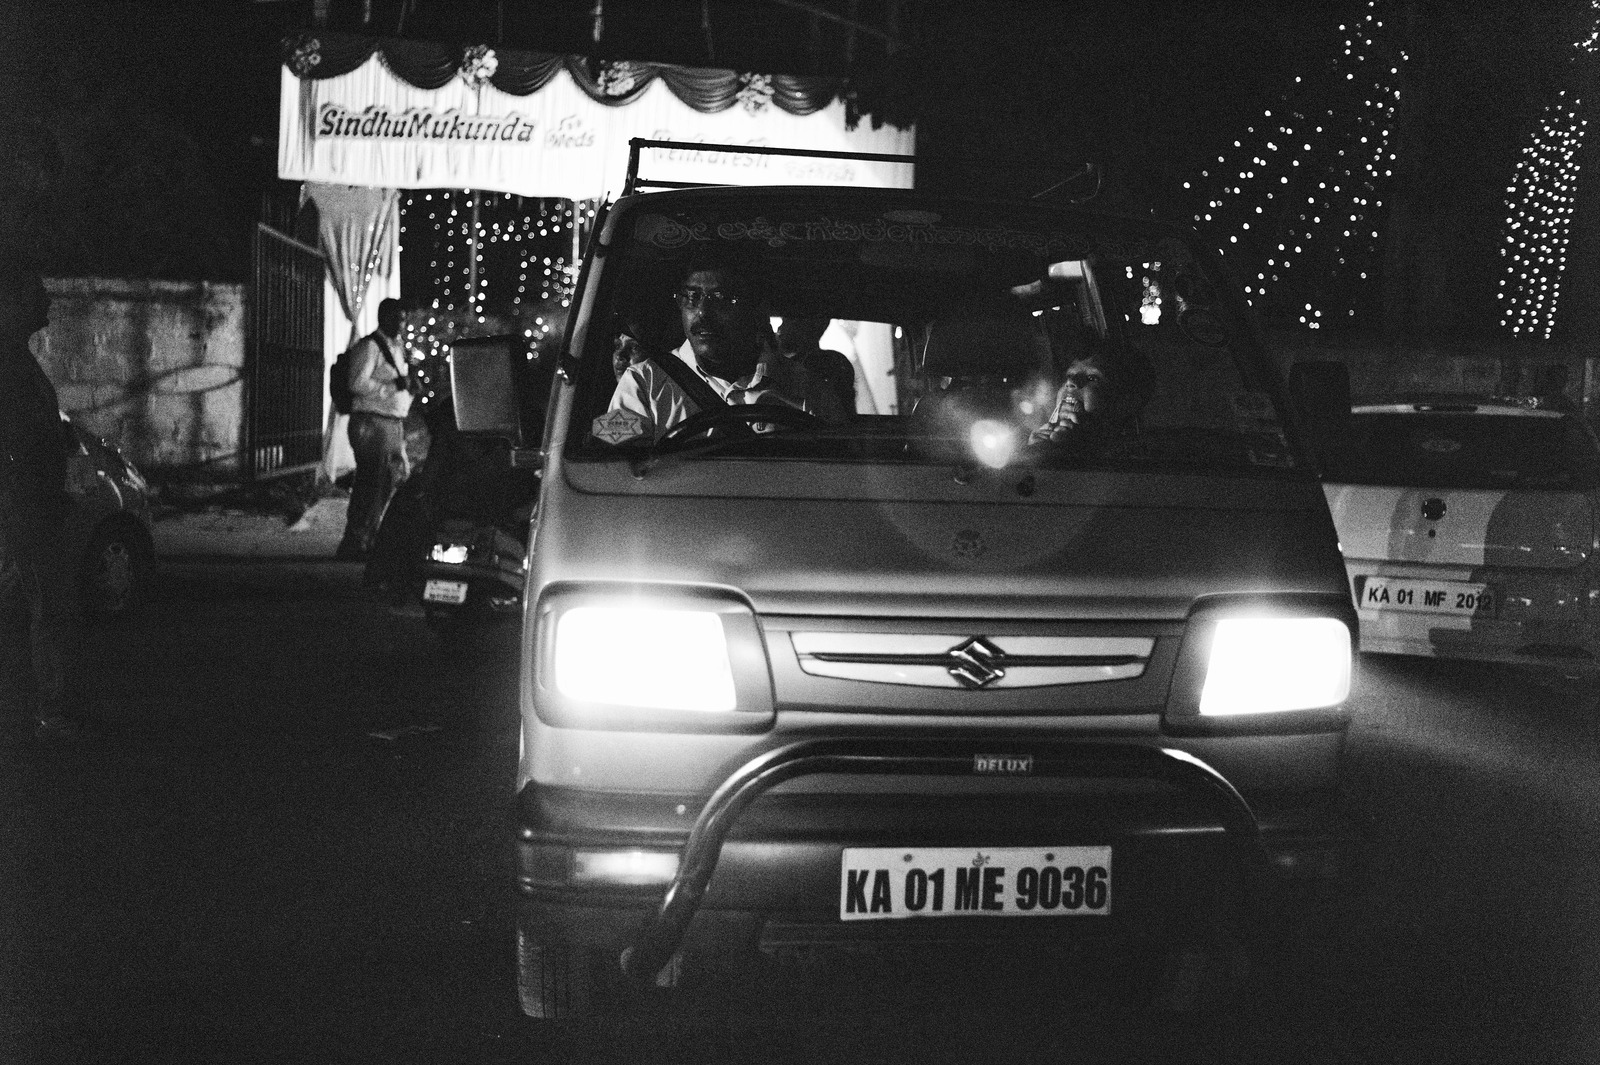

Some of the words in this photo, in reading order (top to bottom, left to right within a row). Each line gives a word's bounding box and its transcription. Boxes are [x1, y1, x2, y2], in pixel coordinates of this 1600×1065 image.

[1368, 587, 1390, 604] KA
[1397, 588, 1414, 605] 01
[1424, 590, 1447, 607] MF
[1456, 593, 1492, 611] 2012
[977, 757, 1029, 772] DELUX
[846, 869, 892, 913] KA
[904, 867, 945, 912] 01
[954, 867, 1005, 912] ME
[1015, 866, 1108, 911] 9036
